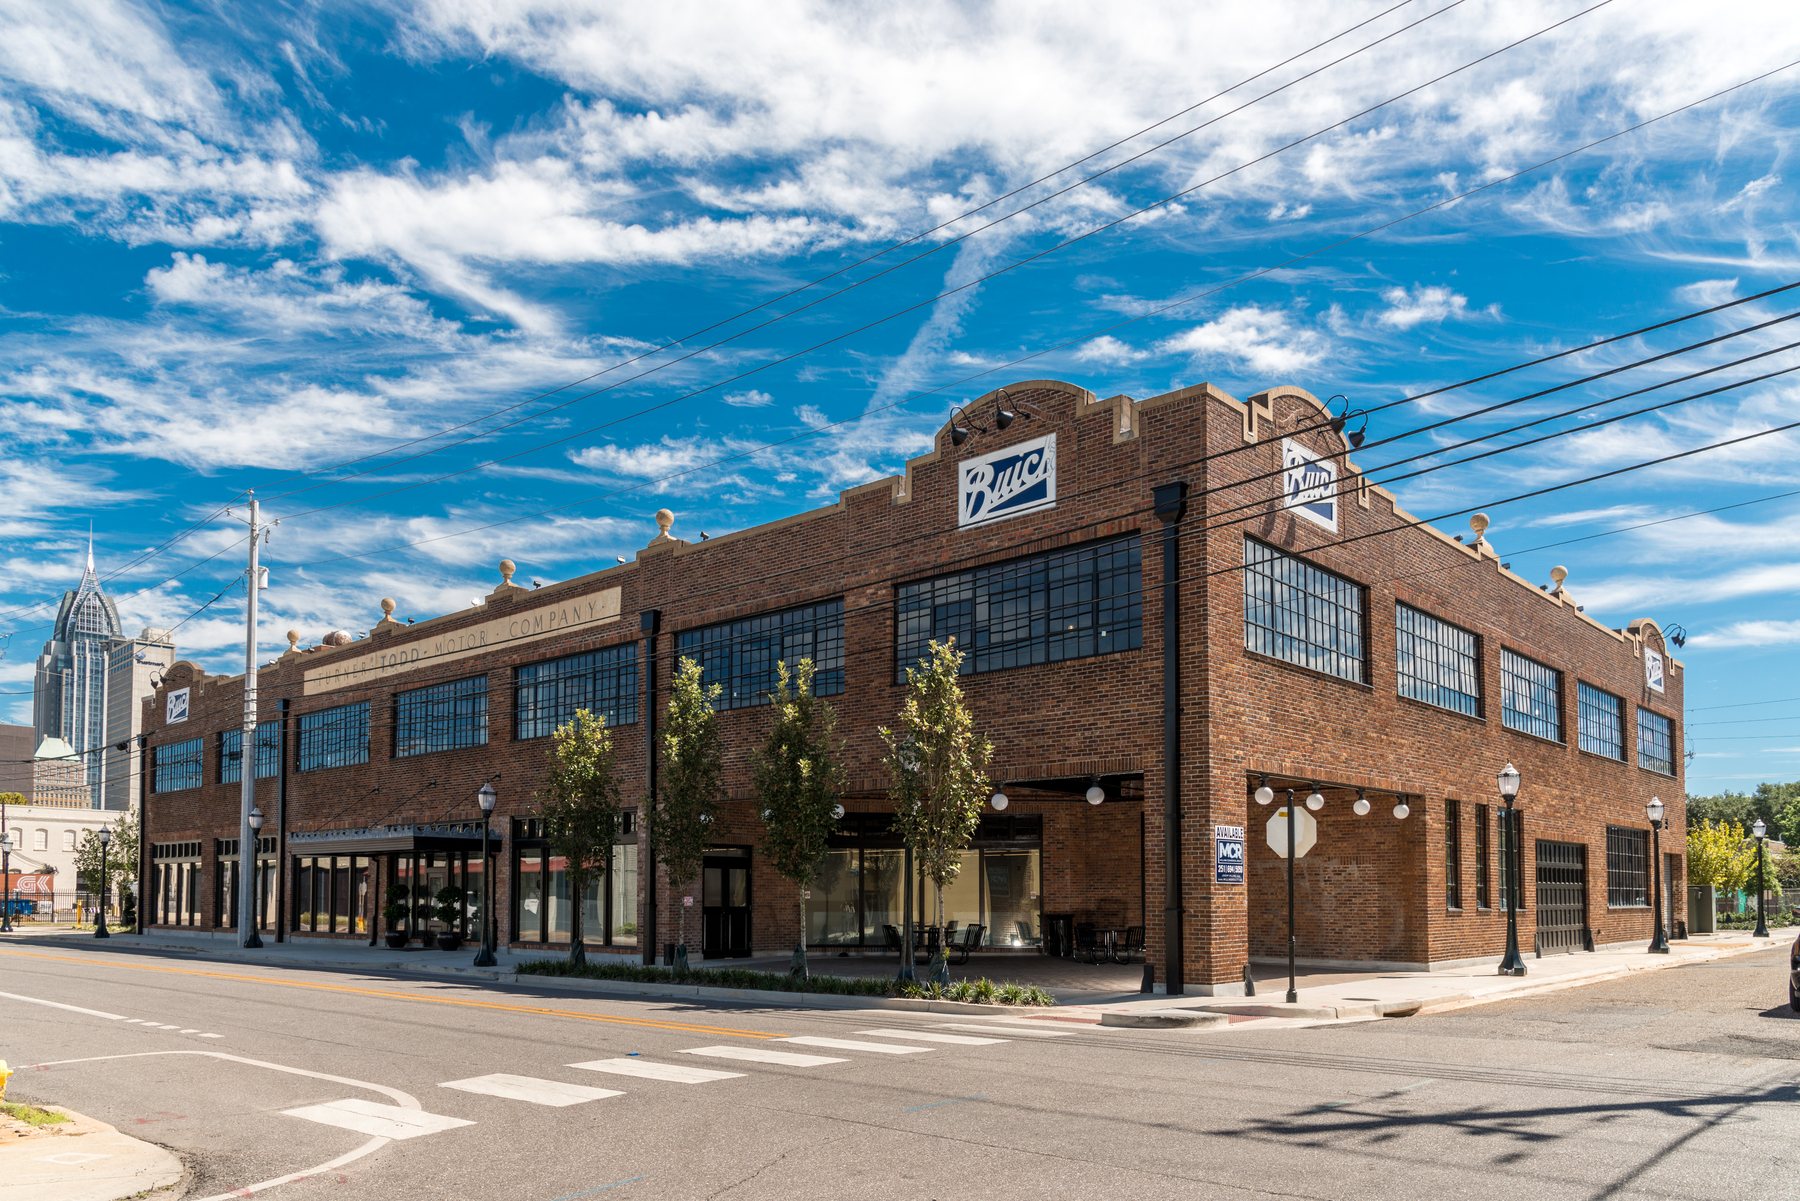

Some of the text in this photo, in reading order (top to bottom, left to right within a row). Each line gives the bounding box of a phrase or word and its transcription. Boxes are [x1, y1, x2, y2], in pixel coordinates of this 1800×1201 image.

[1284, 449, 1336, 508] Buic
[318, 600, 597, 687] TURNER TODD MOTOR COMPANY
[168, 692, 189, 720] Buic
[1216, 826, 1243, 839] AVAILABLE
[1219, 842, 1242, 860] MCR
